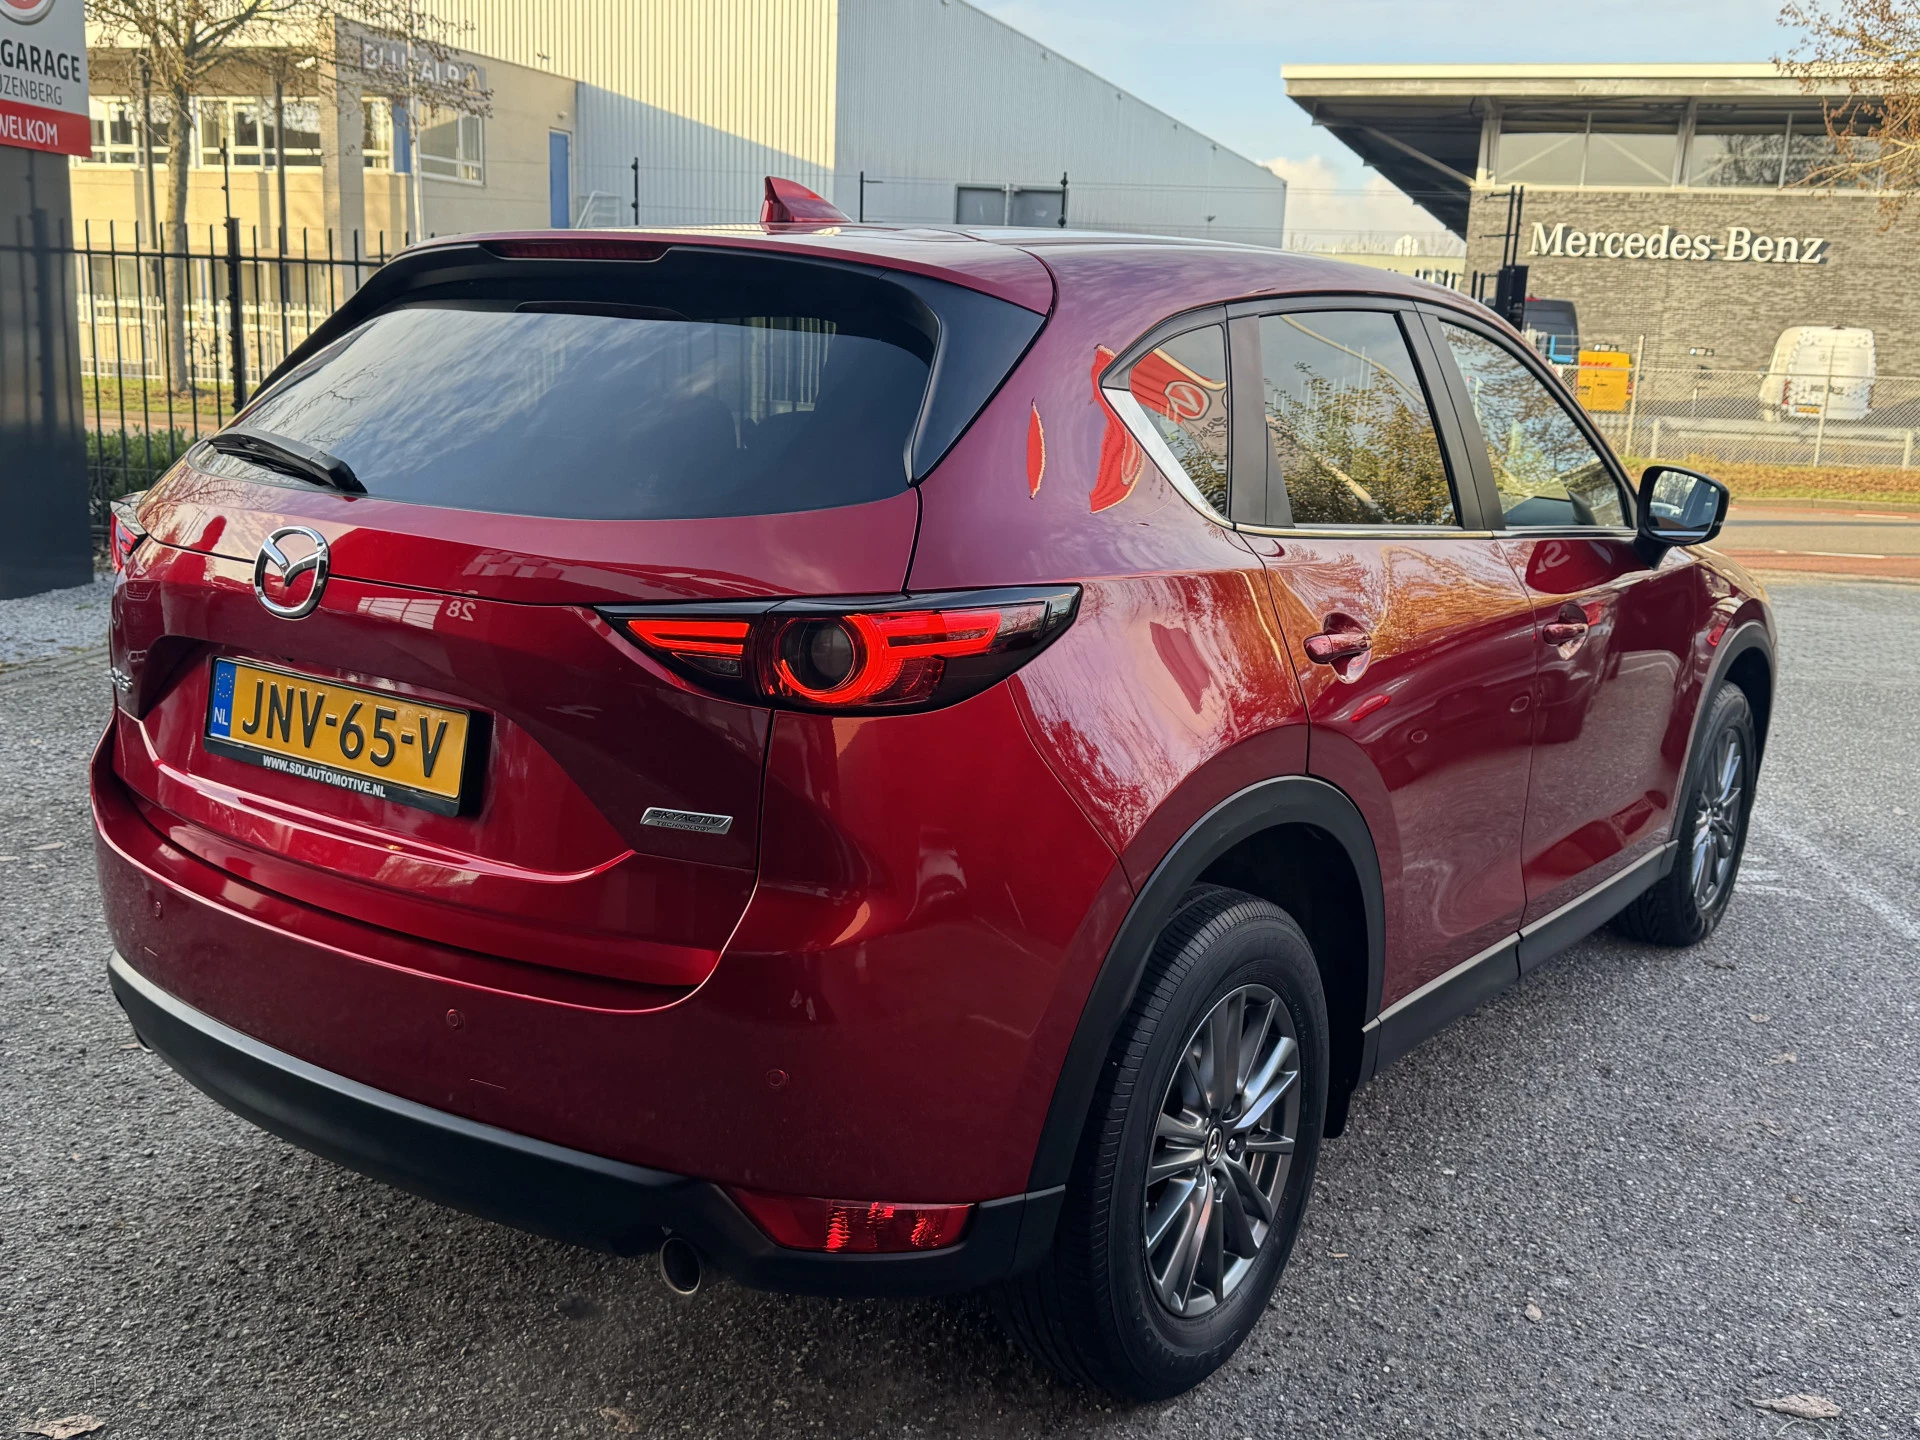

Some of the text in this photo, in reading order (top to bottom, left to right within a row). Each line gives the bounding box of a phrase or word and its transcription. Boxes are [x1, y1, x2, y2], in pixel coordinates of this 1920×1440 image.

[0, 38, 81, 83] GARAGE
[0, 74, 62, 106] ZENBERG
[1528, 222, 1825, 264] Mercedes-Benz
[213, 707, 229, 727] NL
[242, 678, 448, 779] JNV-65-V
[263, 755, 386, 798] WWW.SDLAUTOMOTIVE.NL
[651, 811, 722, 824] SKYACTIV
[656, 820, 712, 832] TECHNOLOGY
